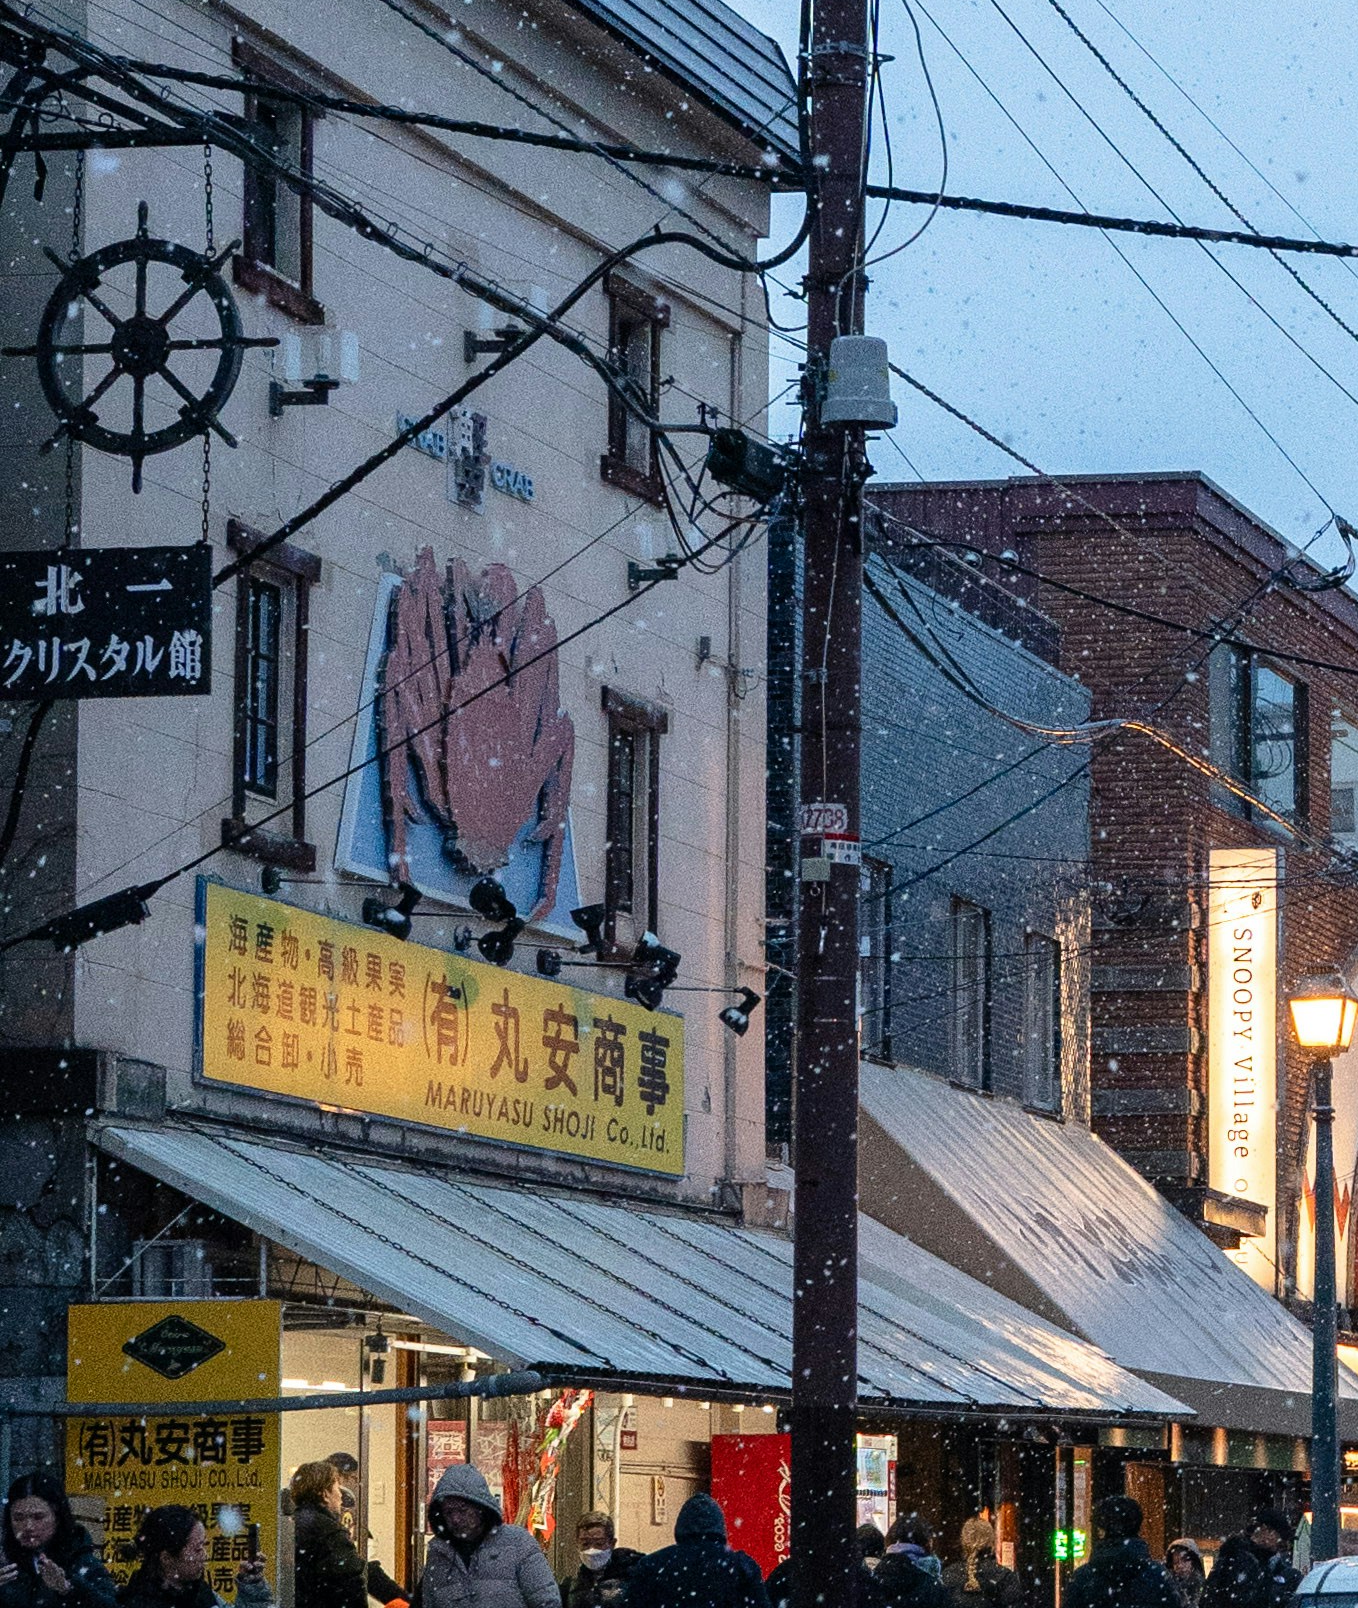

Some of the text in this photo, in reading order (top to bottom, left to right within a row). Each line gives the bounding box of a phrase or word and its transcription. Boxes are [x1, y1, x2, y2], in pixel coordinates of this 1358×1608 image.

[3, 629, 203, 687] クリスタル館
[227, 966, 405, 1049] 北海道観光土産品
[1233, 928, 1253, 1041] SNOOPY
[424, 1080, 534, 1128] MARUYASU
[542, 1105, 596, 1142] SHOJI
[1227, 1056, 1255, 1158] Village
[84, 1470, 156, 1491] MARUYASU
[161, 1470, 203, 1489] SHOJI
